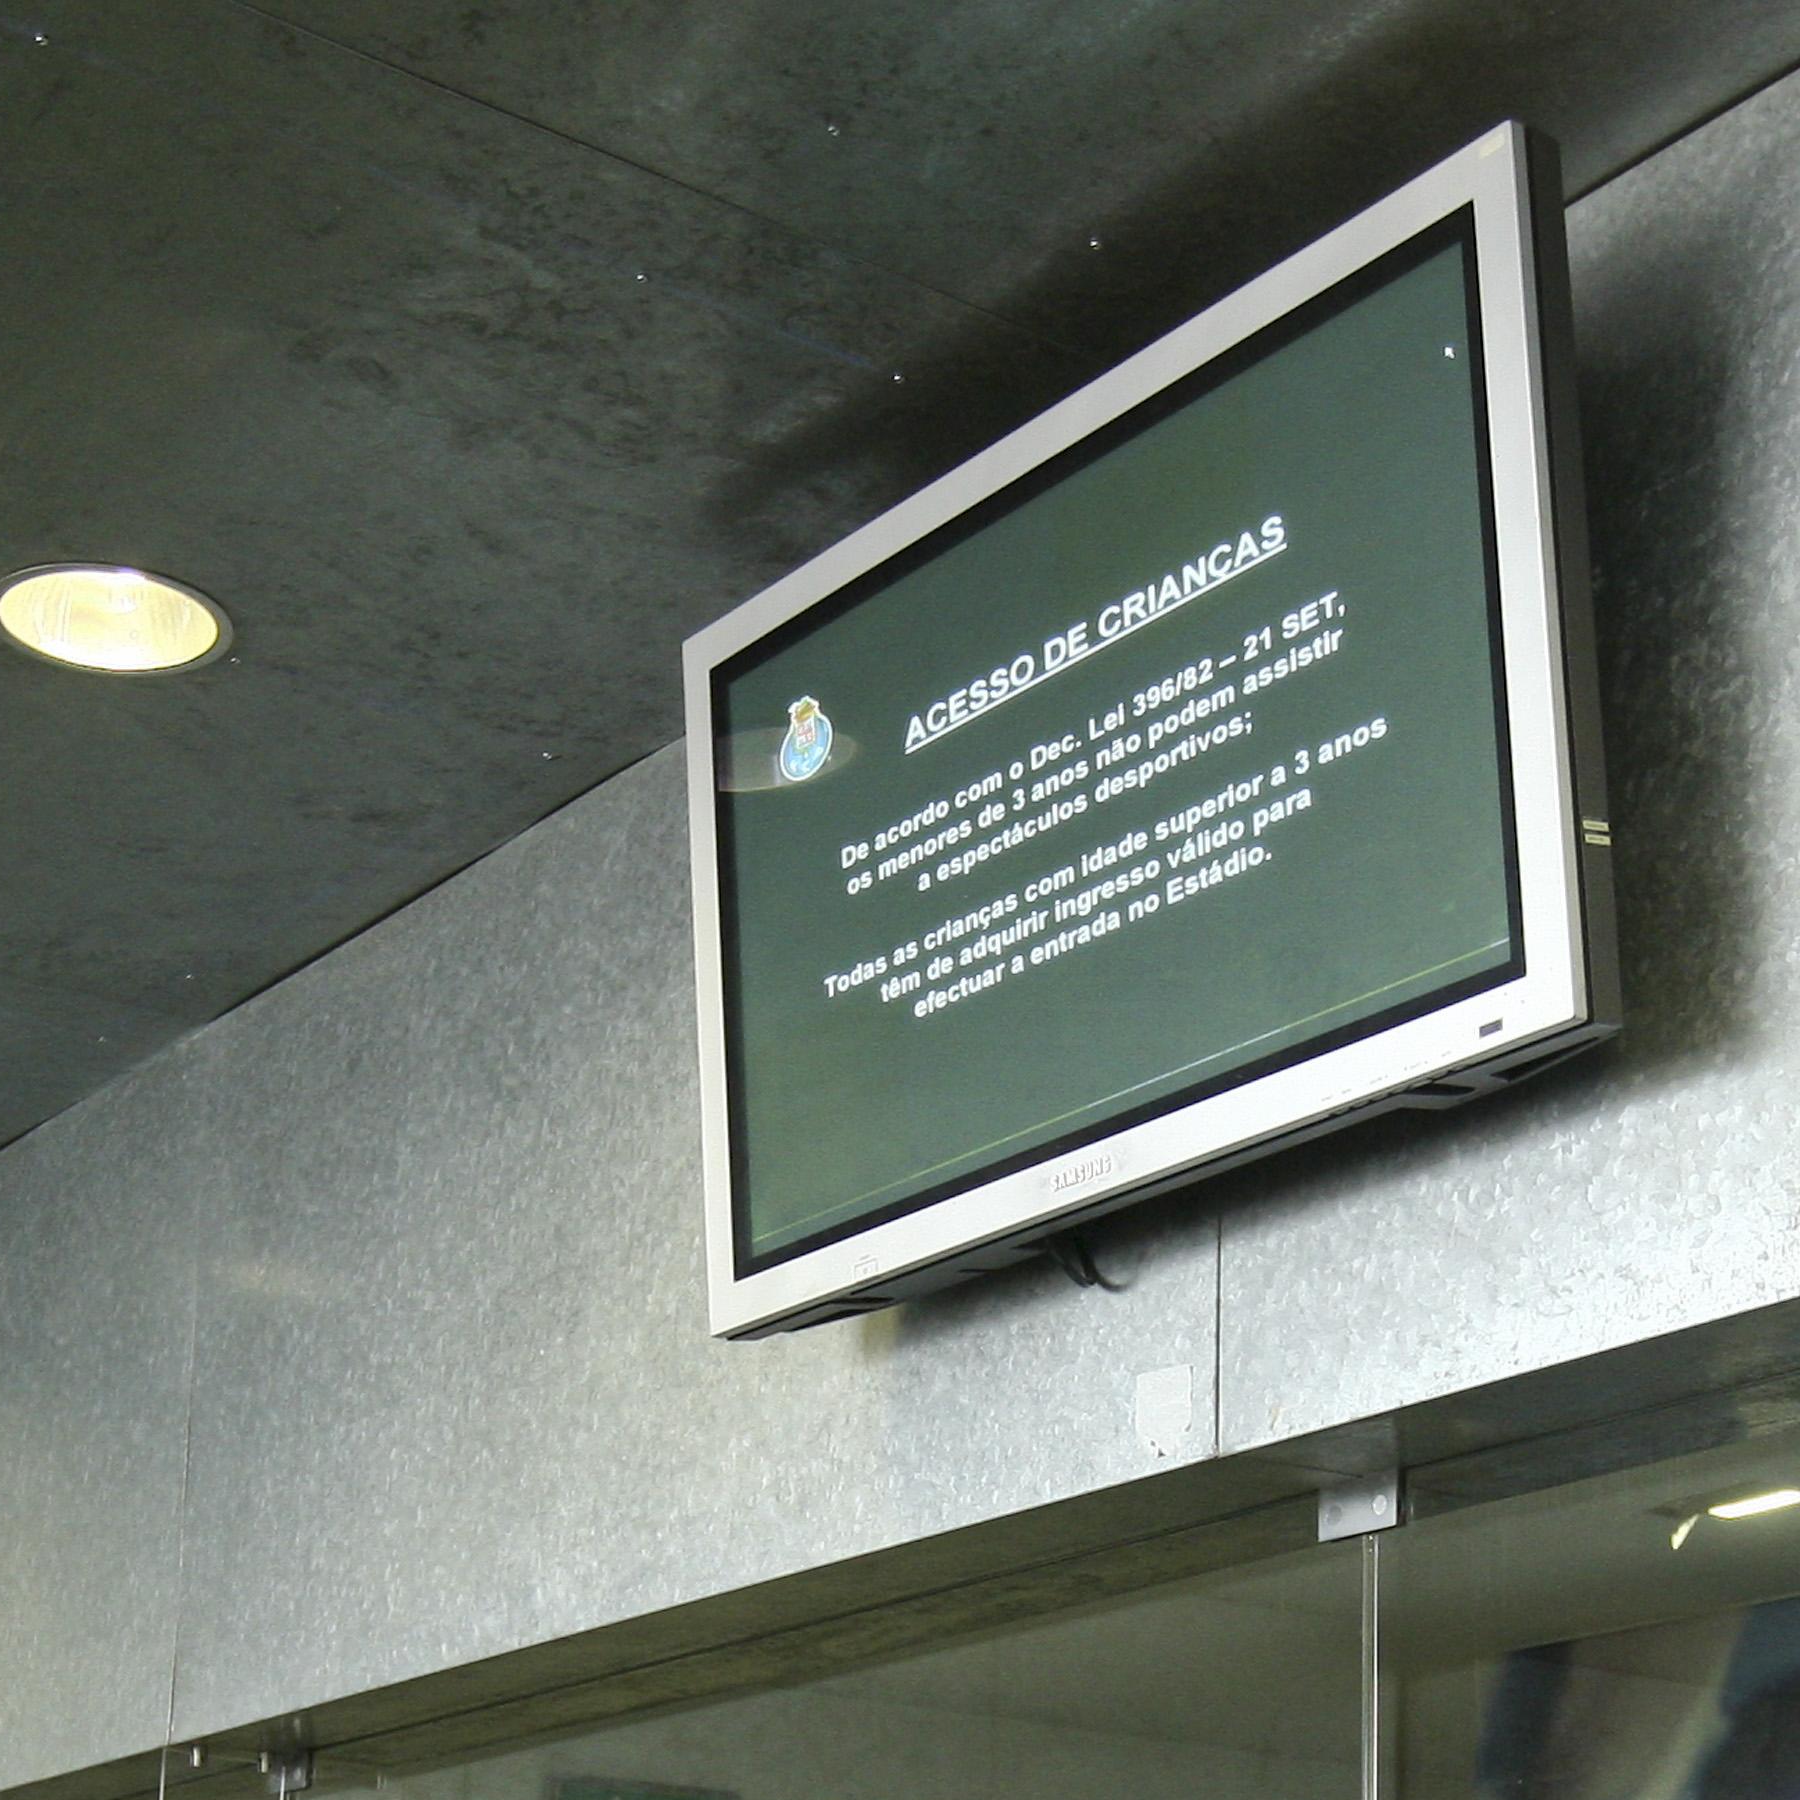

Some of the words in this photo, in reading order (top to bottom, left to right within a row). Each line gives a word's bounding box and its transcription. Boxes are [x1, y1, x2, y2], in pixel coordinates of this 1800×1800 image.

[840, 841, 870, 869] De
[874, 800, 950, 852] acordo
[954, 771, 1003, 809] com
[1008, 761, 1025, 780] o
[1029, 734, 1083, 771] Dec.
[1088, 702, 1125, 741] Lei
[1132, 657, 1214, 717] 396/82
[1243, 625, 1272, 662] 21
[1281, 590, 1346, 640] SET,
[904, 655, 1036, 749] ACESSO
[1043, 621, 1089, 671] DE
[1097, 515, 1286, 638] CRIANÇAS
[823, 956, 888, 998] Todas
[892, 940, 919, 967] as
[923, 893, 1019, 951] crianças
[1023, 865, 1076, 903] com
[1080, 831, 1149, 878] idade
[1154, 774, 1265, 841] superior
[1269, 765, 1287, 787] a
[1294, 749, 1311, 775] 3
[1317, 717, 1388, 765] anos
[846, 870, 874, 895] os
[877, 819, 973, 881] menores
[977, 802, 1006, 829] de
[1011, 788, 1026, 812] 3
[1030, 760, 1090, 803] anos
[1095, 733, 1142, 771] não
[1147, 684, 1236, 750] podem
[1242, 628, 1344, 696] assistir
[917, 872, 932, 892] a
[936, 793, 1089, 882] espectáculos
[1094, 711, 1253, 803] desportivos;
[879, 971, 921, 1003] têm
[926, 955, 955, 981] de
[959, 910, 1050, 967] adquirir
[1054, 859, 1161, 923] ingresso
[1166, 819, 1246, 869] válido
[1252, 788, 1313, 838] para
[913, 962, 1006, 1018] efectuar
[1010, 954, 1025, 975] a
[1029, 910, 1121, 965] entrada
[1127, 893, 1161, 923] no
[1165, 846, 1273, 905] Estádio.
[1051, 1154, 1112, 1192] SAMSUNG
